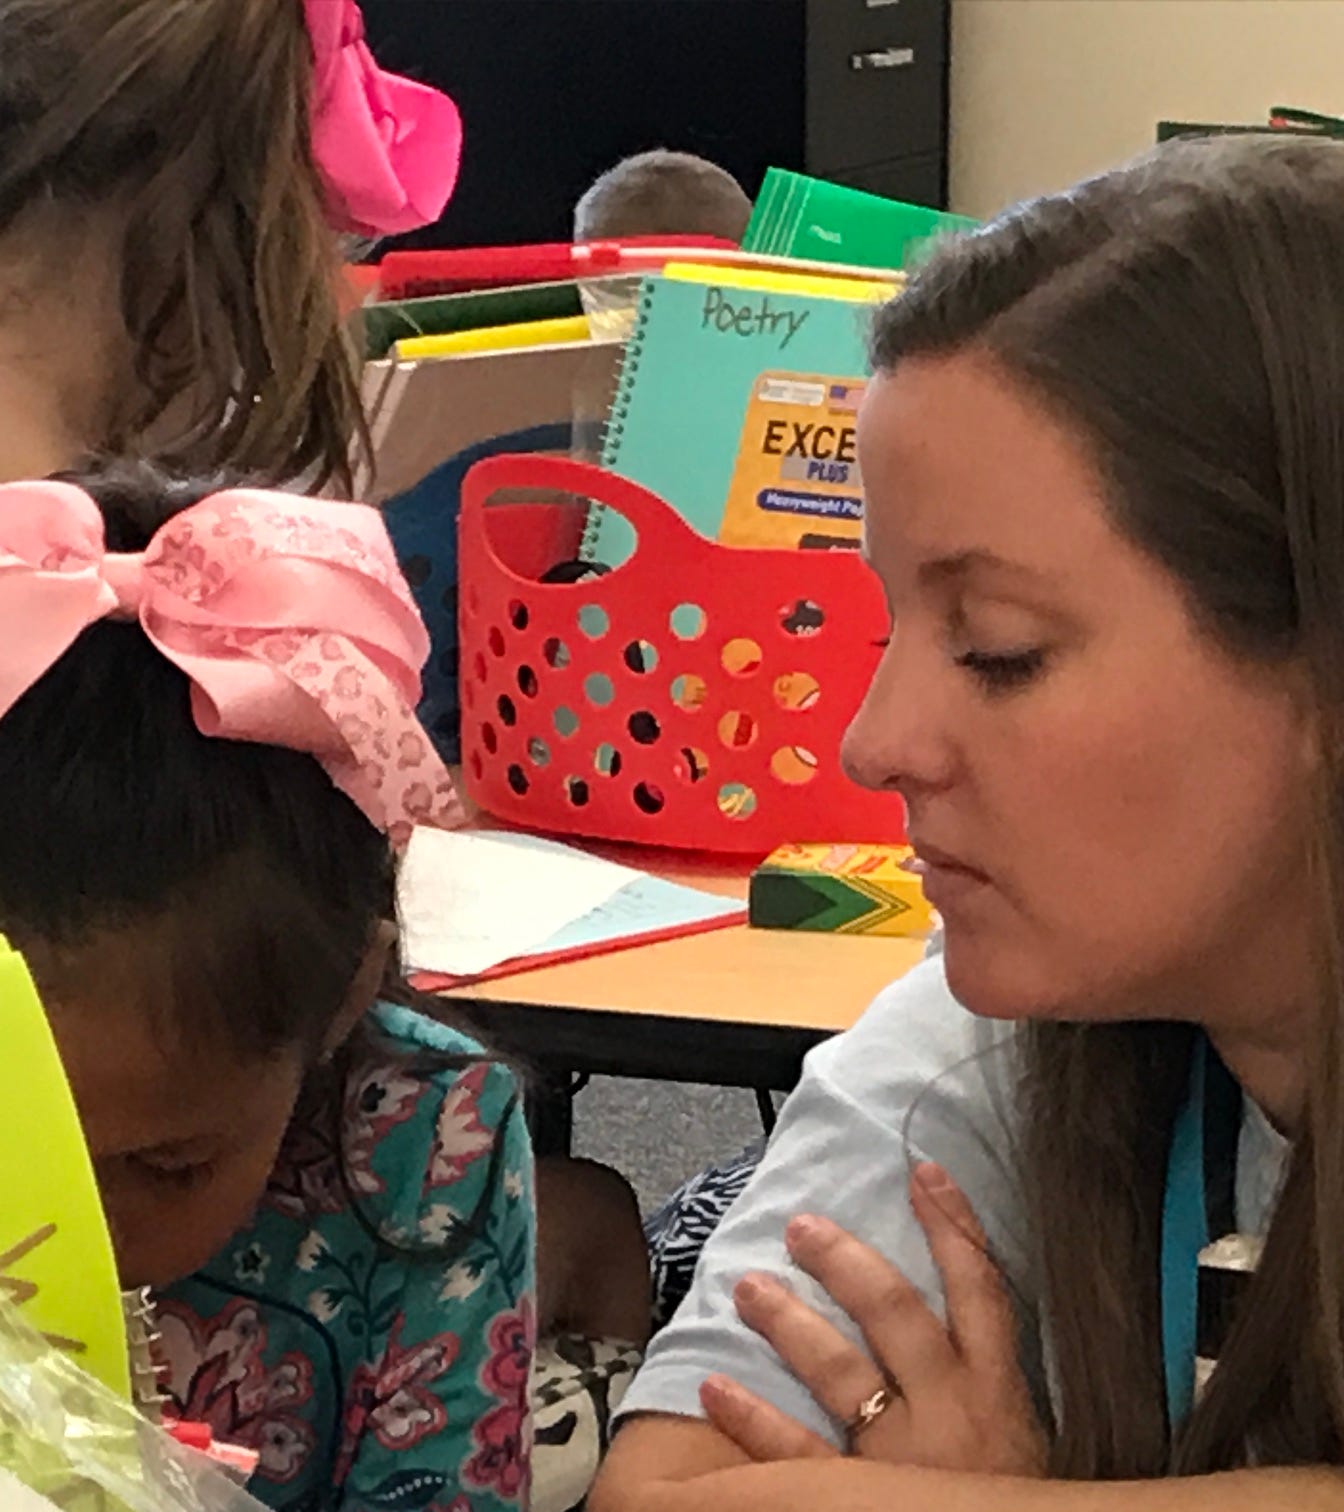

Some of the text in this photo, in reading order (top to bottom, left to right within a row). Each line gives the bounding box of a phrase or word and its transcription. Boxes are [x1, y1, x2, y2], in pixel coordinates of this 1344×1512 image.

[701, 286, 810, 350] Poetry
[762, 419, 857, 464] EXCE
[806, 461, 849, 484] PLUS
